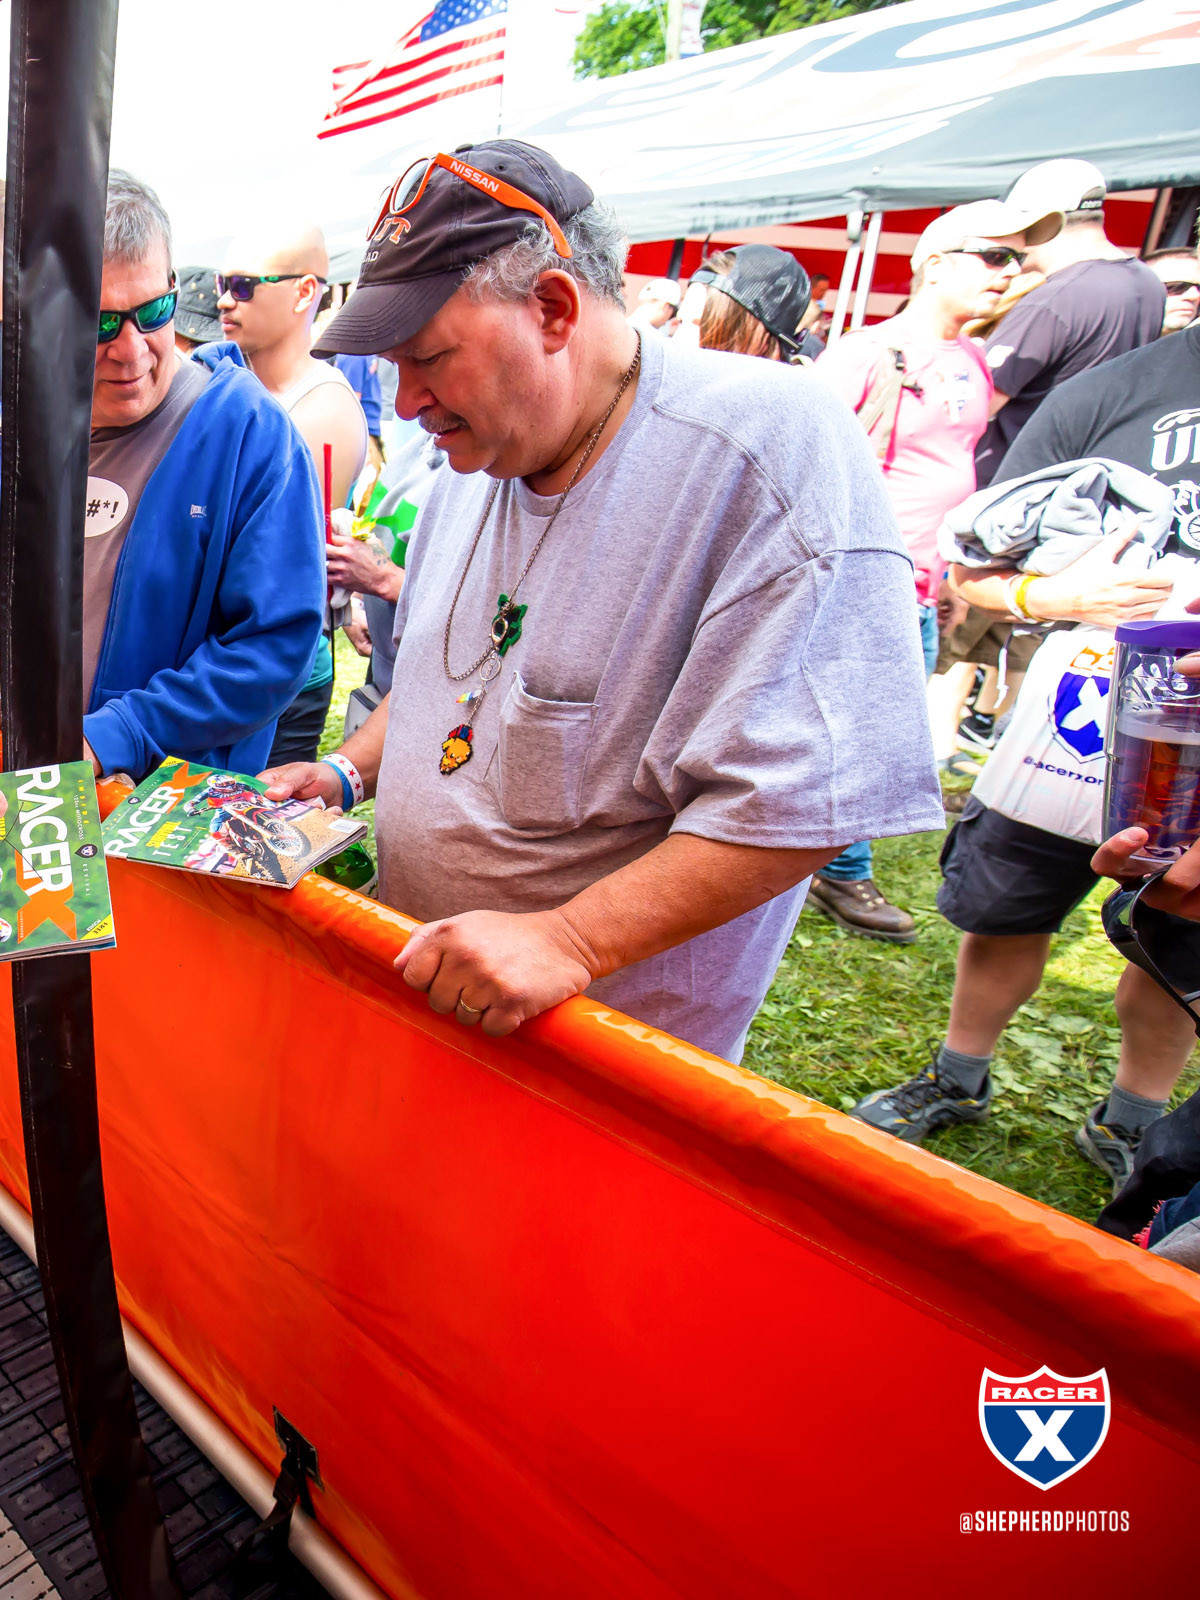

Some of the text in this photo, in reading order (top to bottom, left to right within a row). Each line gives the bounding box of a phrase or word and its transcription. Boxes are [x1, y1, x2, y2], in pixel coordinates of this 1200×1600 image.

[450, 160, 500, 193] NISSAN
[77, 779, 90, 825] INSIDE
[75, 809, 85, 841] MOTOCROSS
[104, 785, 186, 859] RACER
[14, 764, 78, 945] RACER X
[152, 824, 193, 857] TEST
[82, 863, 91, 897] REVIVAL
[92, 920, 109, 936] FREE
